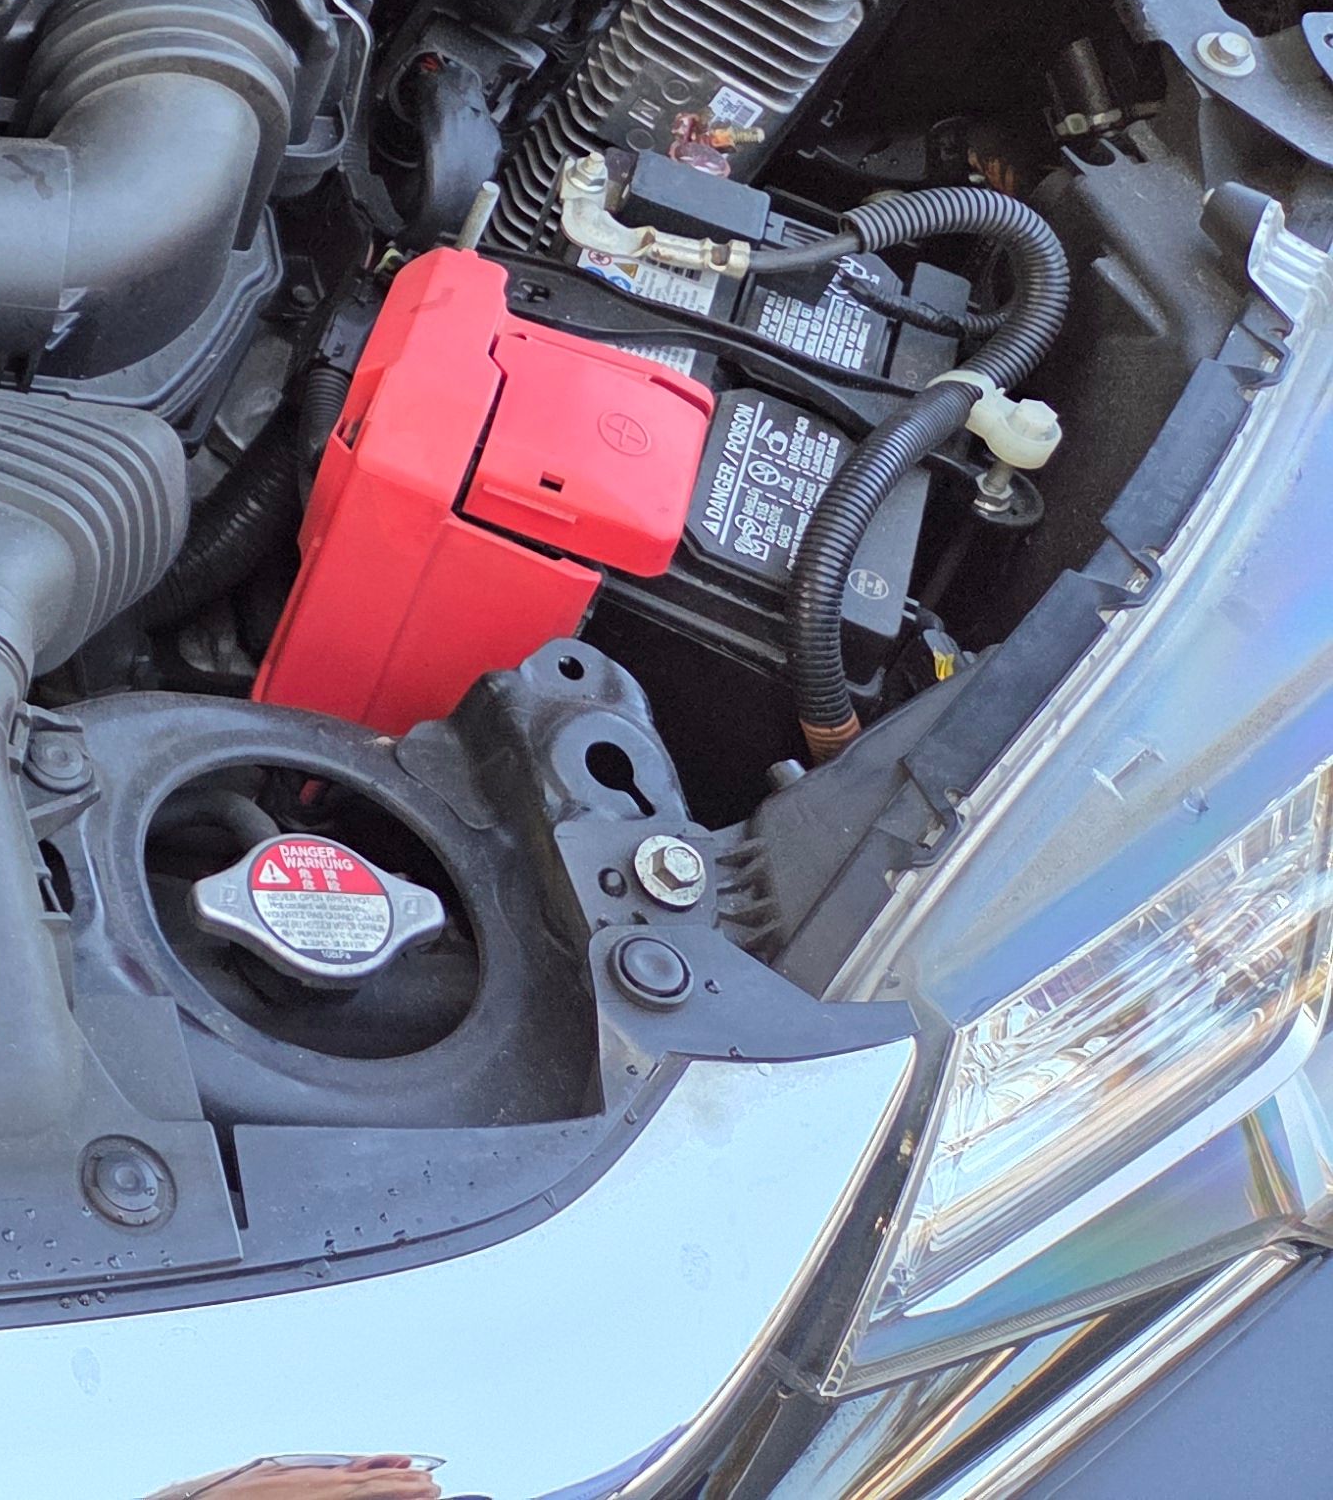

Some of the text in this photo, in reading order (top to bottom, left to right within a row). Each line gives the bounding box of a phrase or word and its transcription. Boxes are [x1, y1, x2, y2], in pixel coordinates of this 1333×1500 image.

[706, 463, 737, 520] DANGER
[725, 404, 754, 454] POISON
[278, 844, 337, 858] DANGER
[283, 856, 354, 871] WARNUNG
